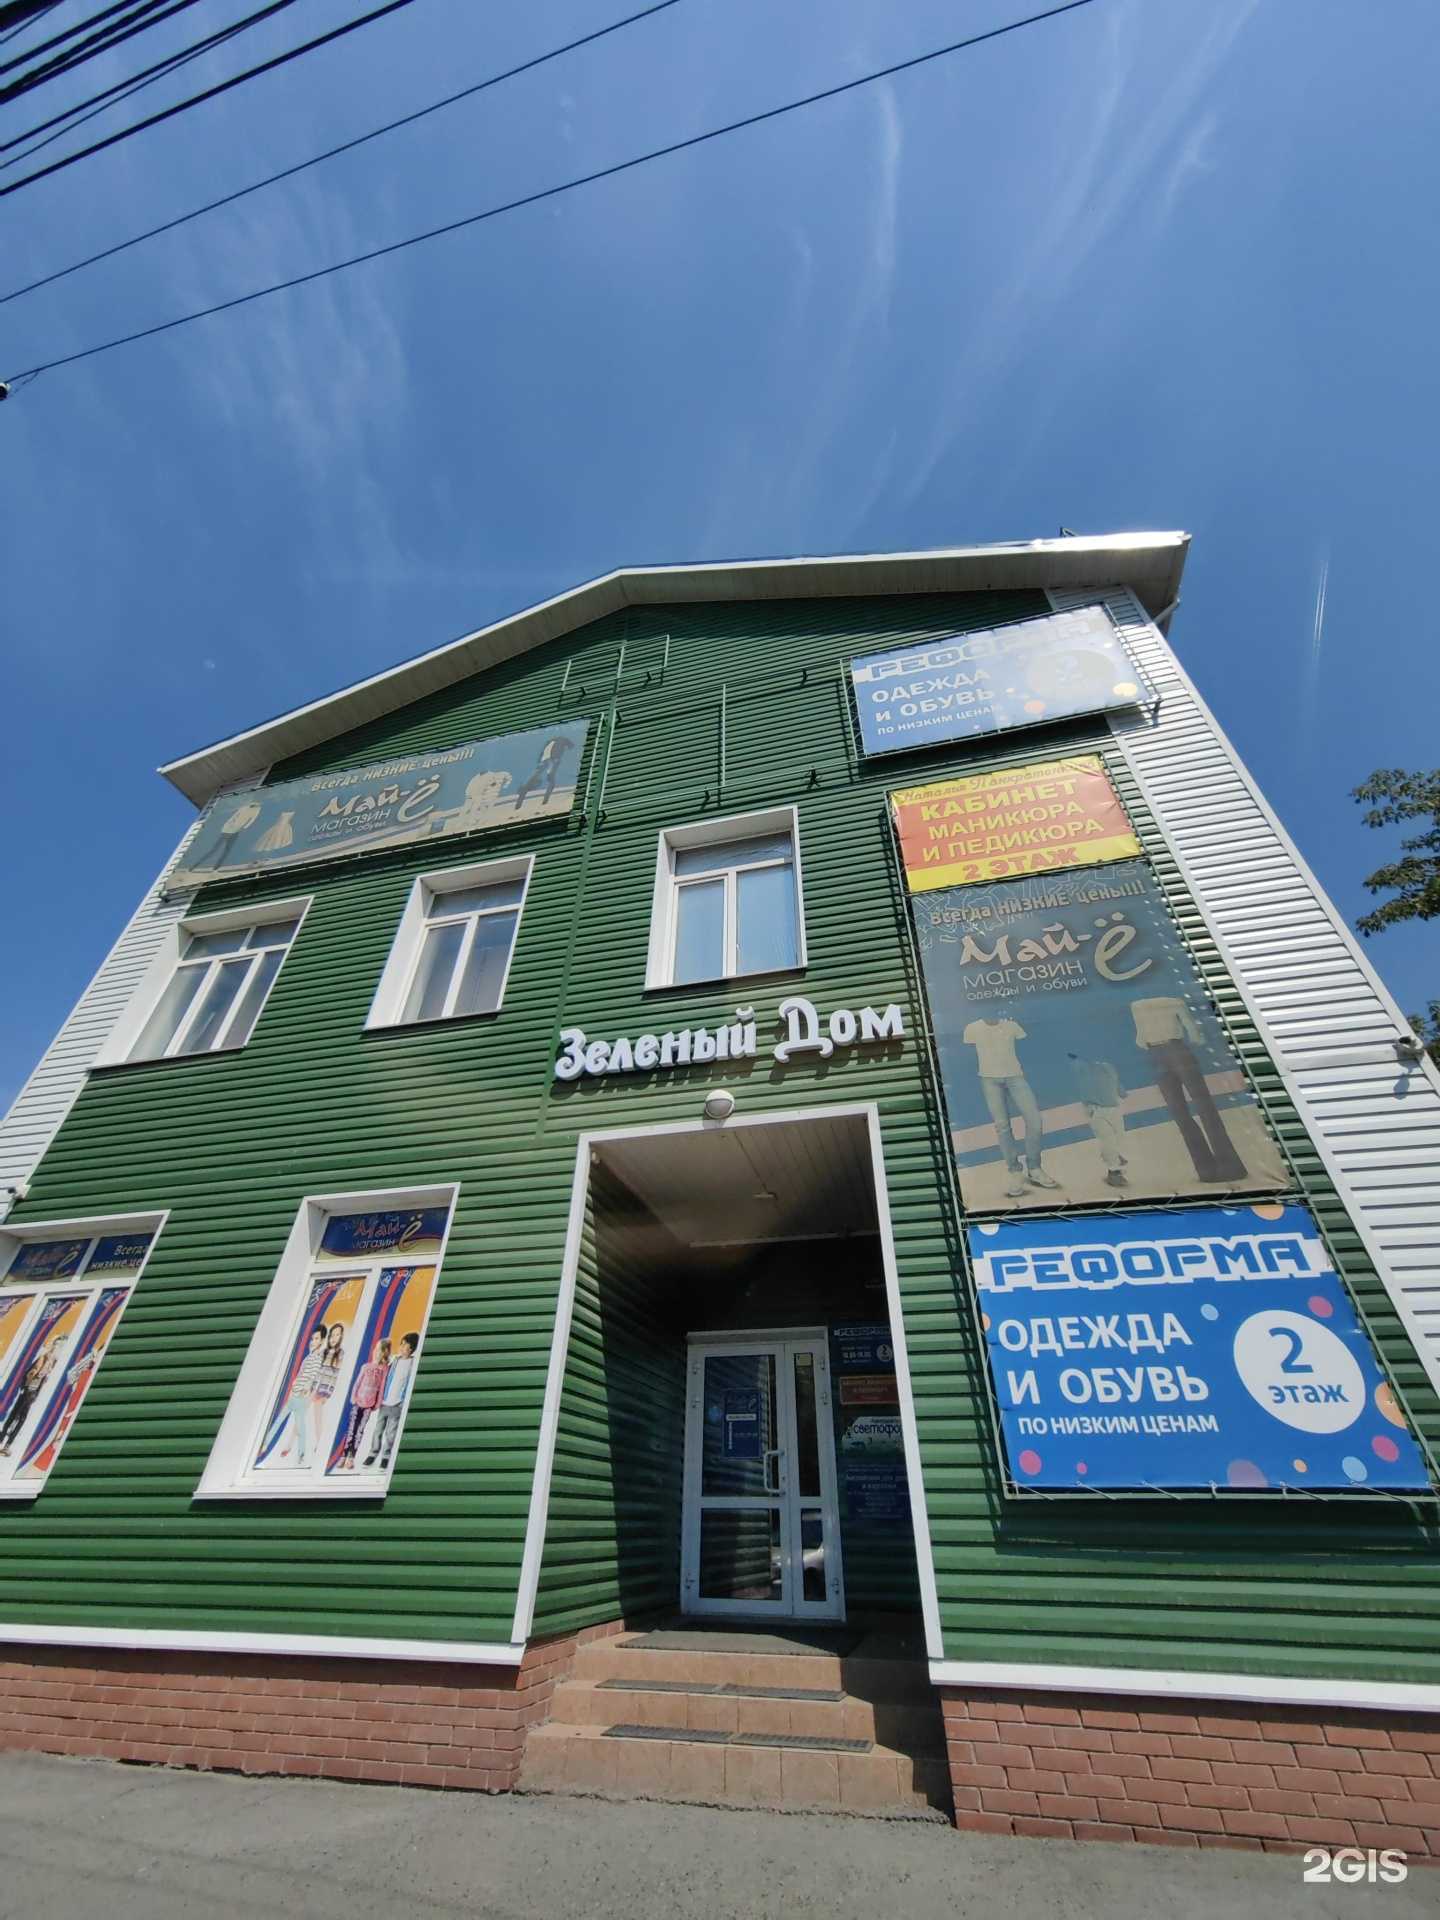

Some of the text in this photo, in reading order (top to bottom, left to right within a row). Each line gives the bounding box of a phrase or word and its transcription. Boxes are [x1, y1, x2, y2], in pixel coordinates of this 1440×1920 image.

[871, 667, 992, 704] ОДЕЖДА
[874, 688, 994, 722] И ОБУВЬ
[877, 724, 894, 736] ПО
[897, 714, 953, 732] НИЗКИМ
[920, 778, 1078, 822] КАБИНЕТ
[923, 818, 1105, 863] И ПЕДИКЮРА
[928, 801, 1085, 841] МАНИКЮРА
[961, 846, 1080, 881] 2 ЭТАЖ
[967, 977, 1088, 1001] одежды и обуви
[555, 997, 906, 1082] Зеленый Дом
[984, 1235, 1322, 1291] РЕФОРМА
[999, 1312, 1194, 1357] ОДЕЖДА
[1268, 1326, 1314, 1374] 2
[1008, 1365, 1210, 1405] И ОБУВЬ
[1269, 1381, 1350, 1405] этаж
[1018, 1413, 1220, 1437] ПО НИЗКИМ ЦЕНАМ
